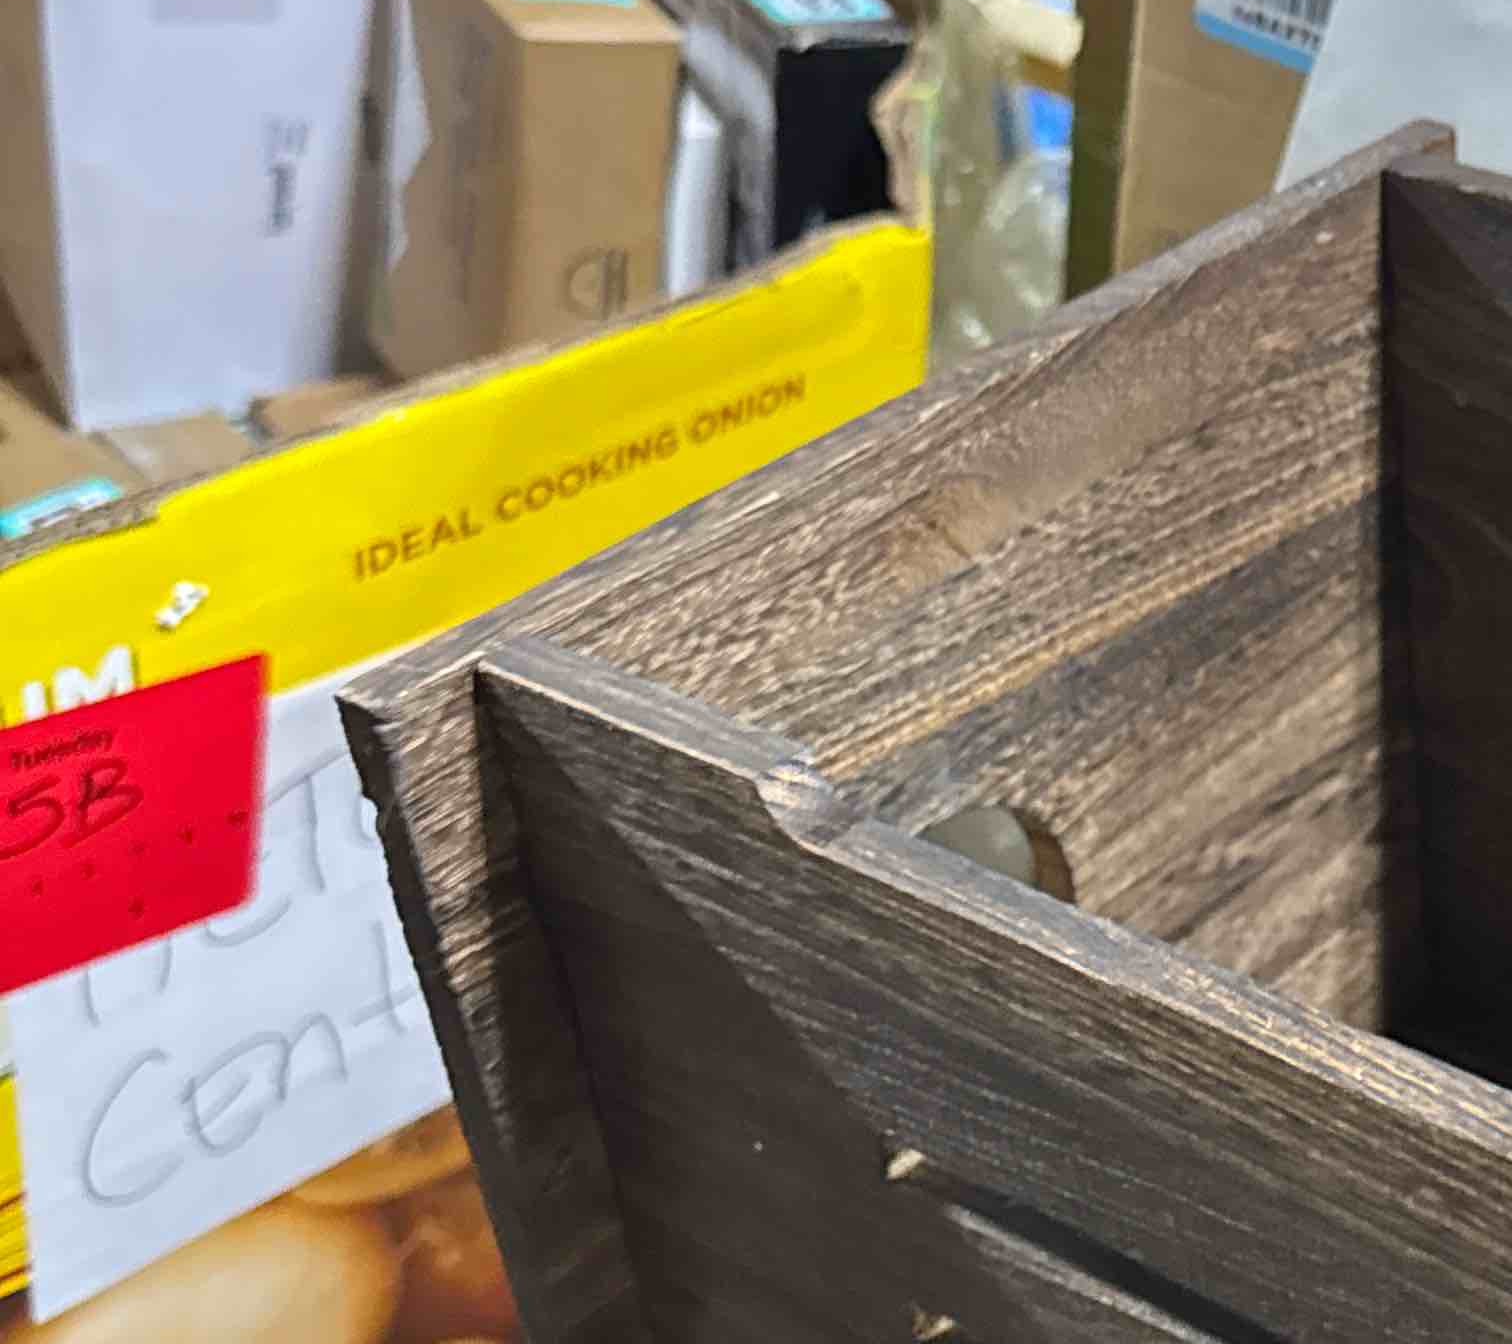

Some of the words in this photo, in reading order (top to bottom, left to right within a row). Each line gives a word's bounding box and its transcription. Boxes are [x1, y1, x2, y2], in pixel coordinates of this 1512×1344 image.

[353, 509, 484, 583] IDEAL
[493, 424, 680, 522] COOKING
[688, 373, 807, 445] ONION
